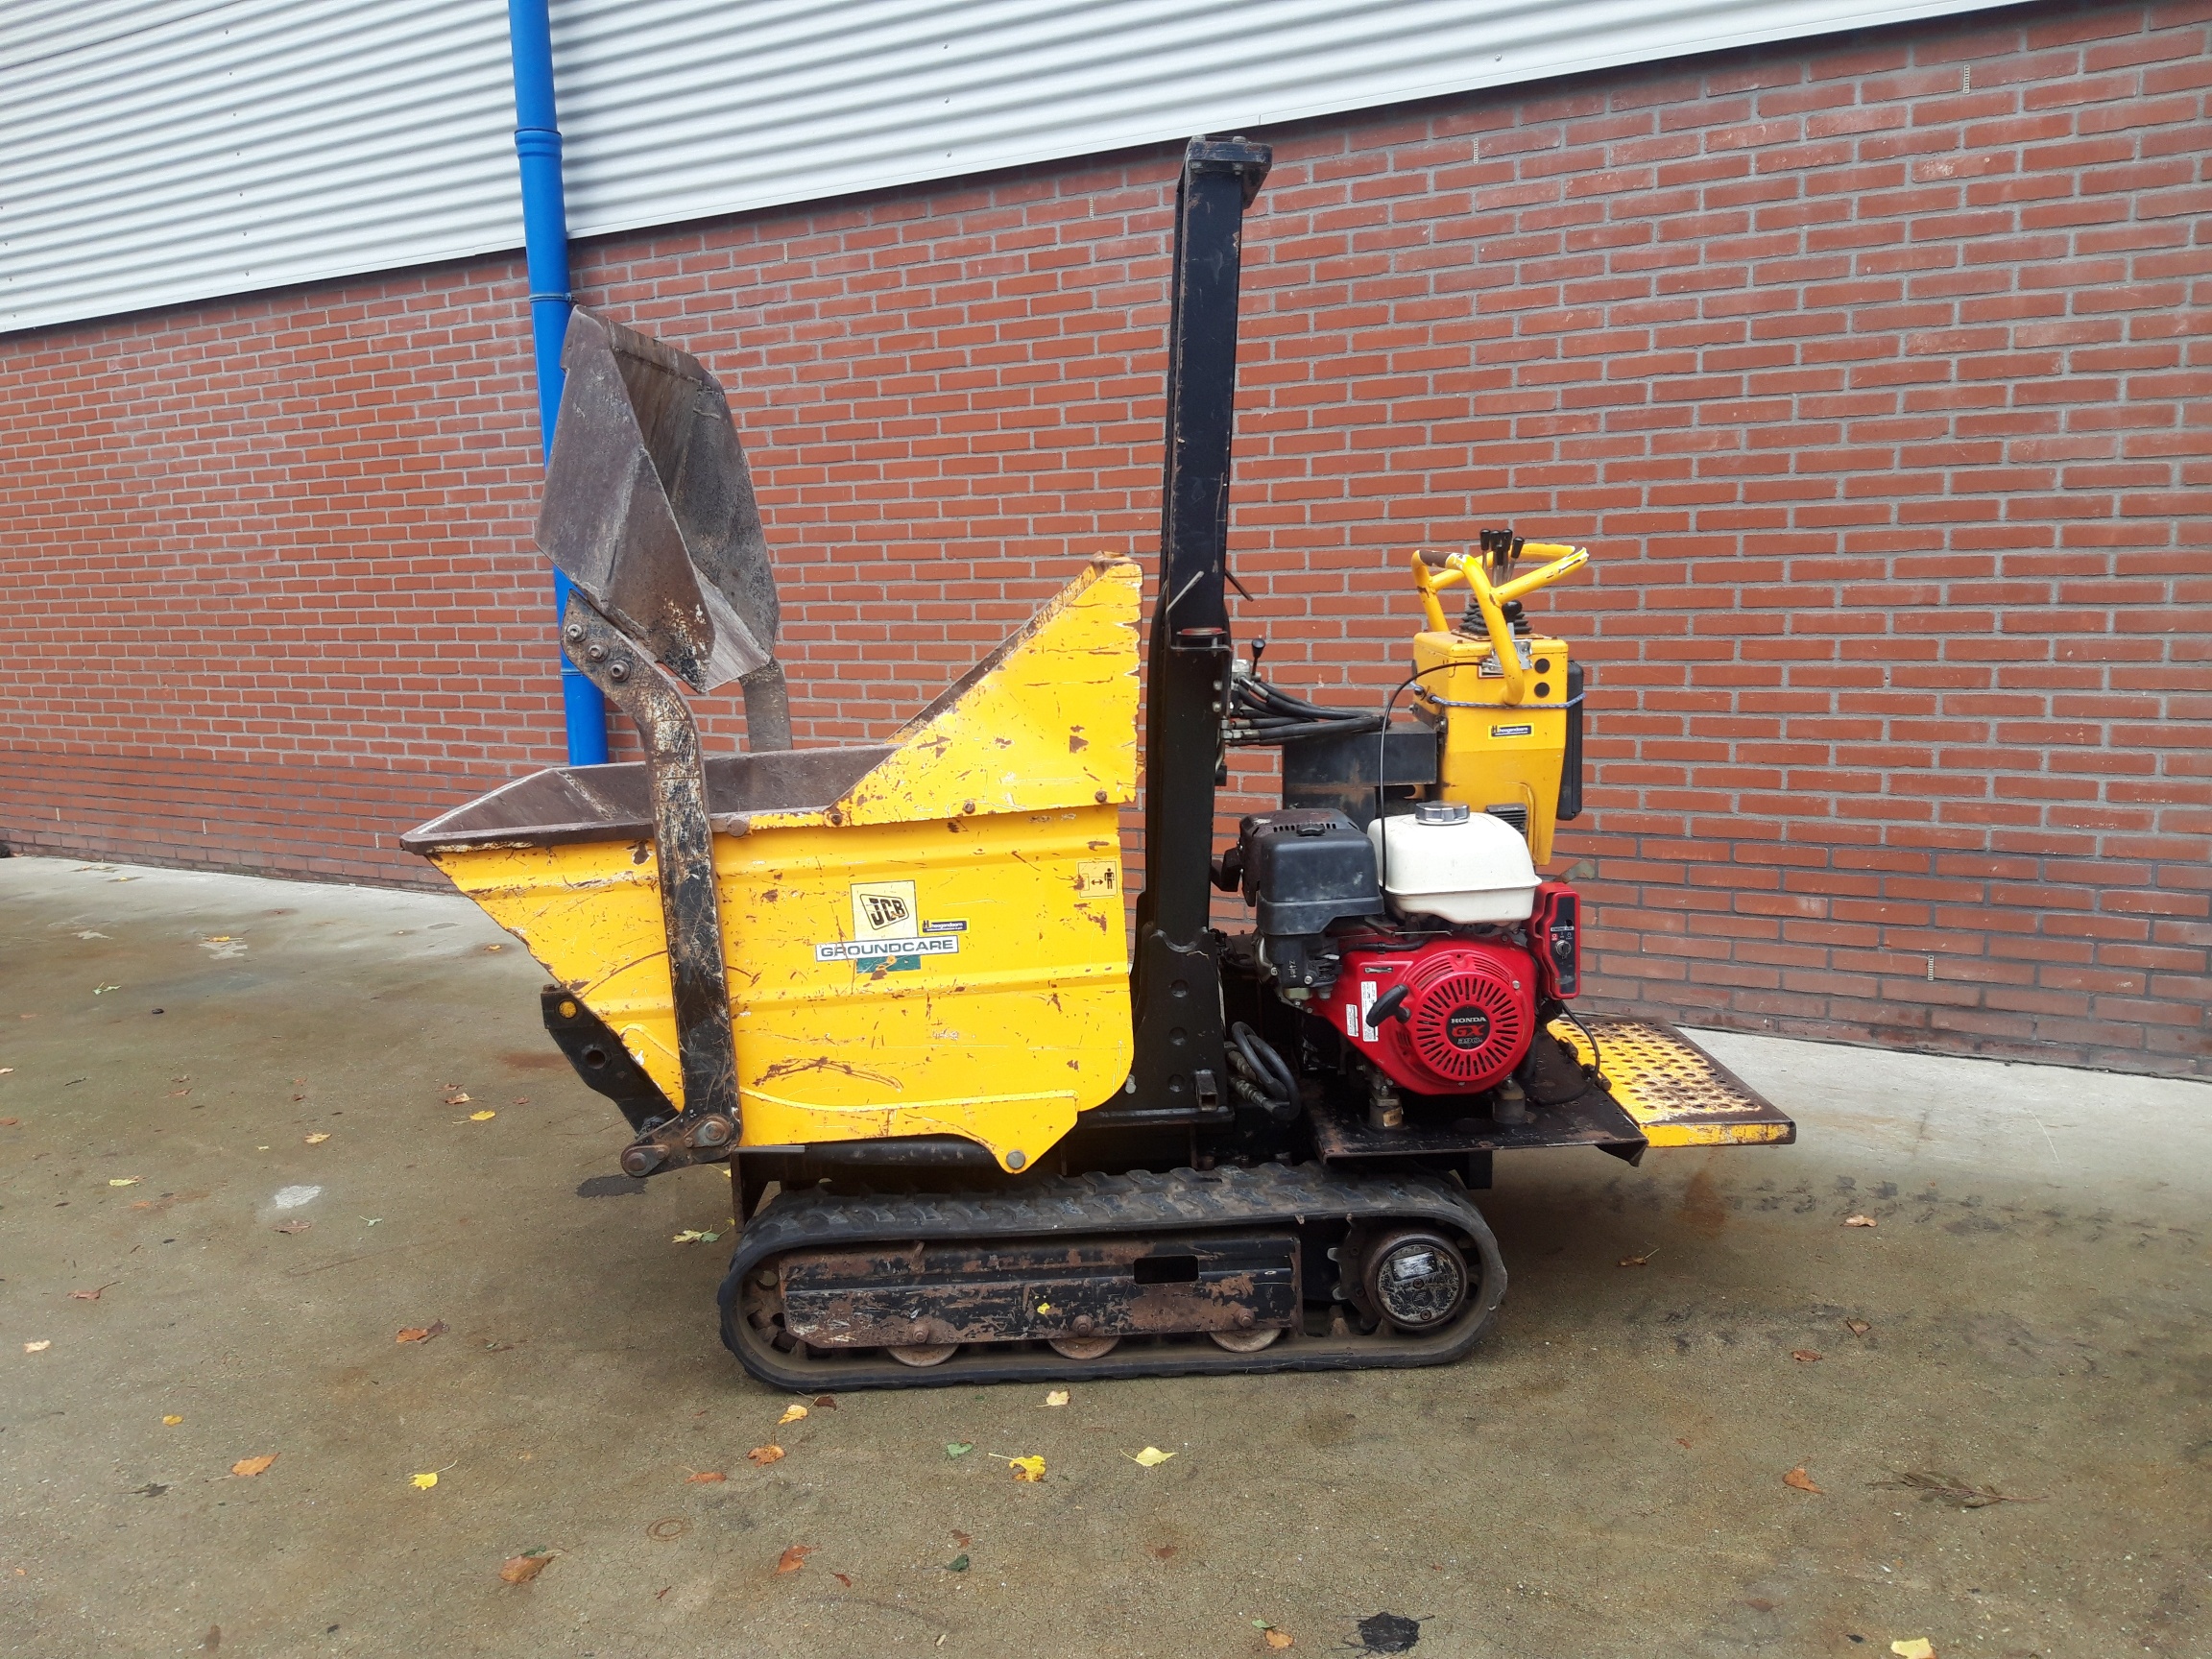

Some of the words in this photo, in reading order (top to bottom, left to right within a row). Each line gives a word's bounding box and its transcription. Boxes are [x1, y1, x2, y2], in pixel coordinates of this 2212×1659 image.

[869, 898, 905, 926] JCB
[821, 939, 953, 958] GROUNDCARE
[1452, 1025, 1484, 1037] GX
